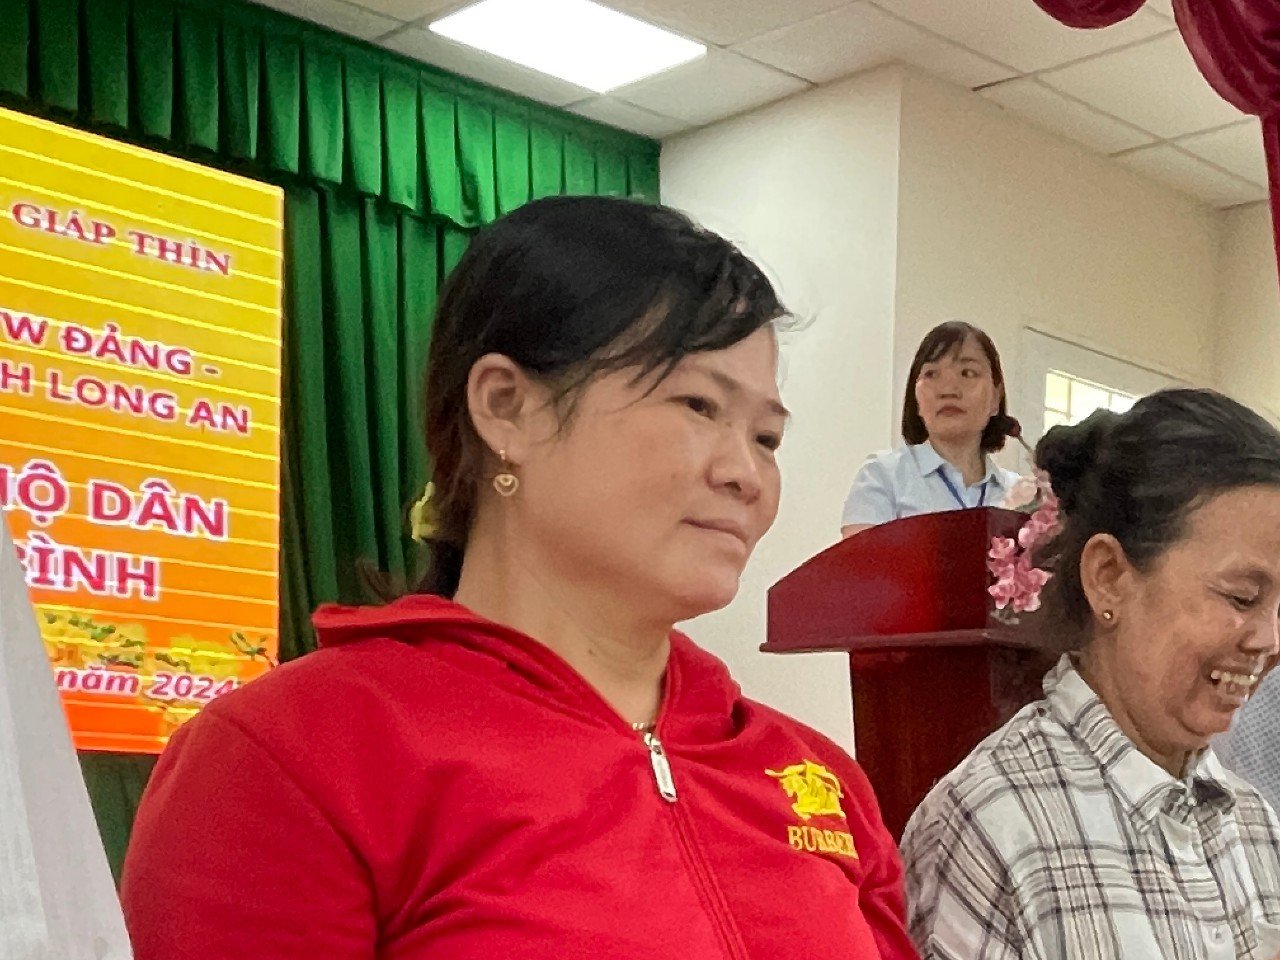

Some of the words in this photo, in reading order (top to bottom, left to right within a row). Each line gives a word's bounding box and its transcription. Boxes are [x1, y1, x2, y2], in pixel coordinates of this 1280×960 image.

[11, 202, 117, 245] GIÁP
[129, 230, 231, 276] THÌN
[62, 323, 192, 375] ĐẢNG
[50, 371, 177, 421] LONG
[189, 400, 249, 434] AN
[92, 480, 226, 539] DÂN
[16, 533, 158, 598] ÌNH
[56, 665, 141, 694] năm
